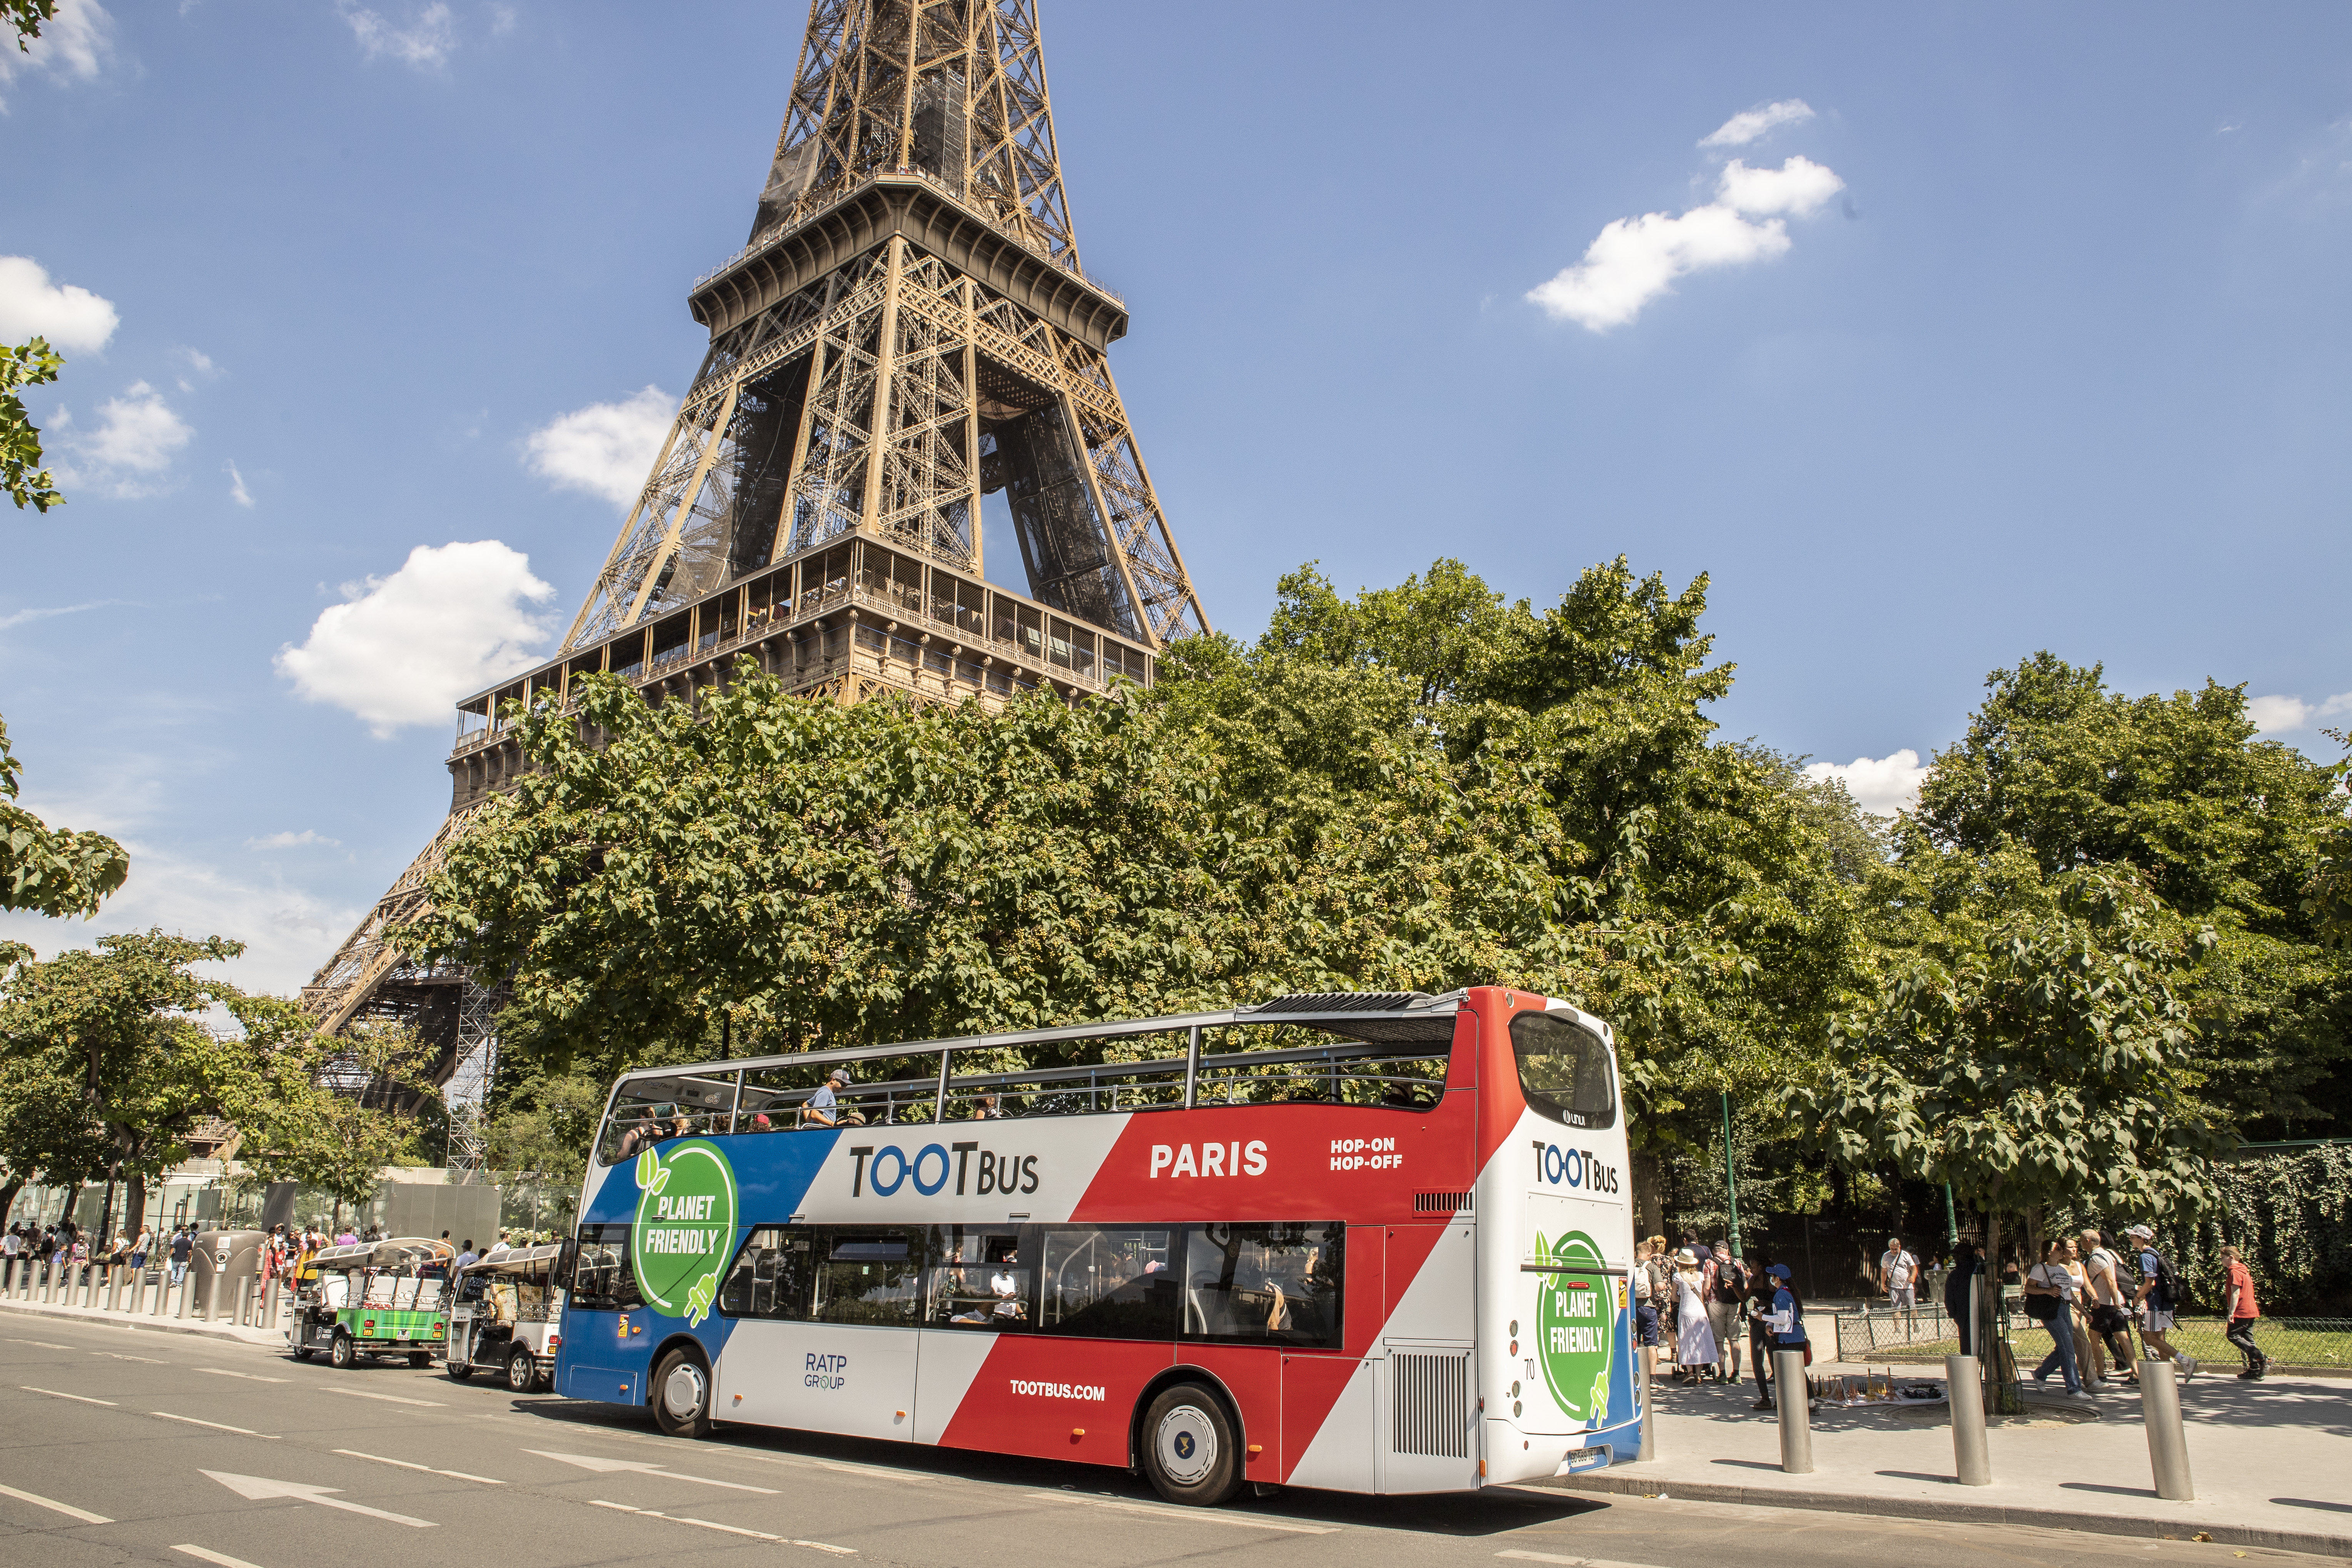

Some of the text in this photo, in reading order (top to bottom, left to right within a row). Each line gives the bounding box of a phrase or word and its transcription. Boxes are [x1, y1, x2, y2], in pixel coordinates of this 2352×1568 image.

[1330, 1137, 1395, 1154] HOP-ON
[1149, 1140, 1268, 1179] PARIS
[1330, 1154, 1403, 1171] HOP-OFF
[657, 1195, 716, 1220] PLANET
[645, 1229, 719, 1254] FRIENDLY
[1555, 1291, 1597, 1318] PLANET
[1550, 1326, 1604, 1354] FRIENDLY
[805, 1353, 847, 1373] RATP
[1524, 1358, 1535, 1380] 70
[805, 1374, 845, 1390] GROUP
[1010, 1379, 1105, 1401] TOOTBUS.COM
